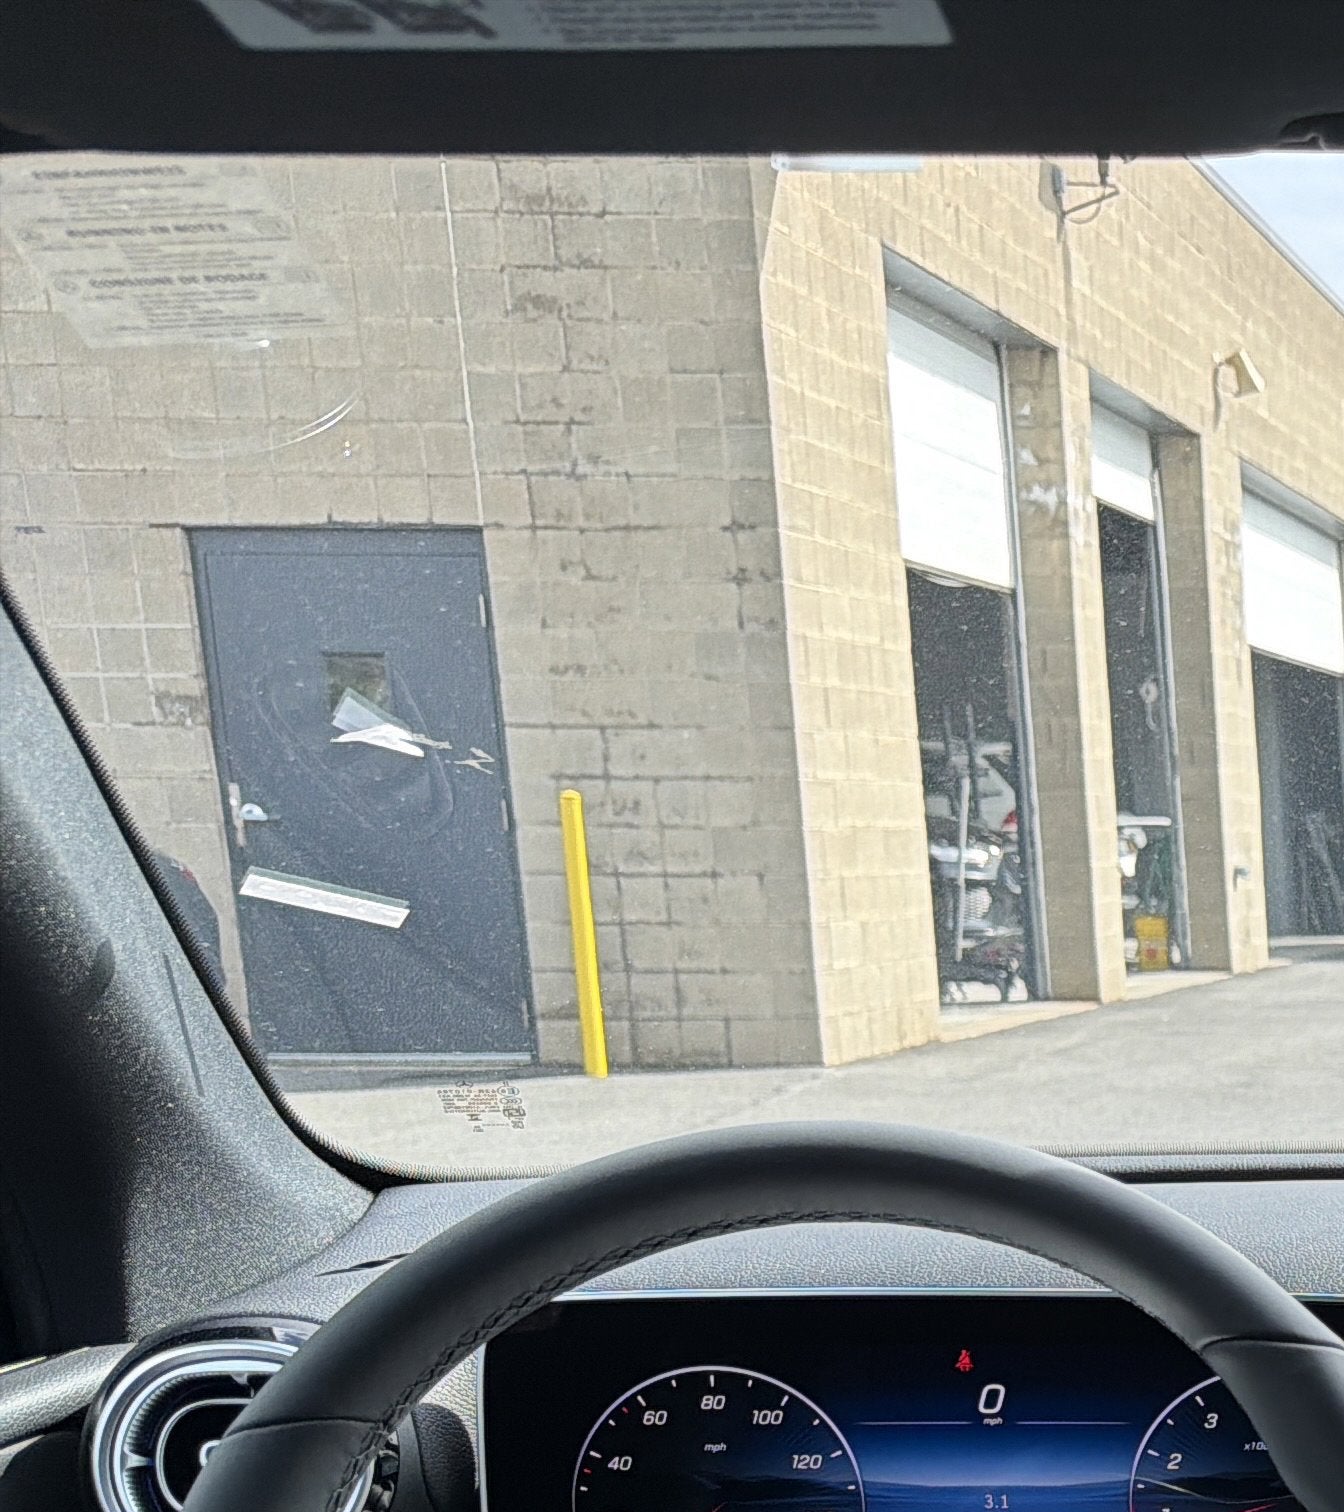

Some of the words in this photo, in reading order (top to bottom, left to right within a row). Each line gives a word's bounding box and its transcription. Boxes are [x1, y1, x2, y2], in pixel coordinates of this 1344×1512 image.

[700, 1395, 725, 1410] 80
[978, 1384, 1005, 1414] 0
[643, 1410, 668, 1425] 60
[752, 1410, 783, 1425] 100
[983, 1416, 1003, 1427] mph
[1204, 1413, 1219, 1430] 3
[704, 1442, 727, 1453] mph
[607, 1456, 633, 1471] 40
[792, 1455, 822, 1470] 120
[1166, 1453, 1183, 1470] 2
[984, 1494, 1009, 1510] 3.1
